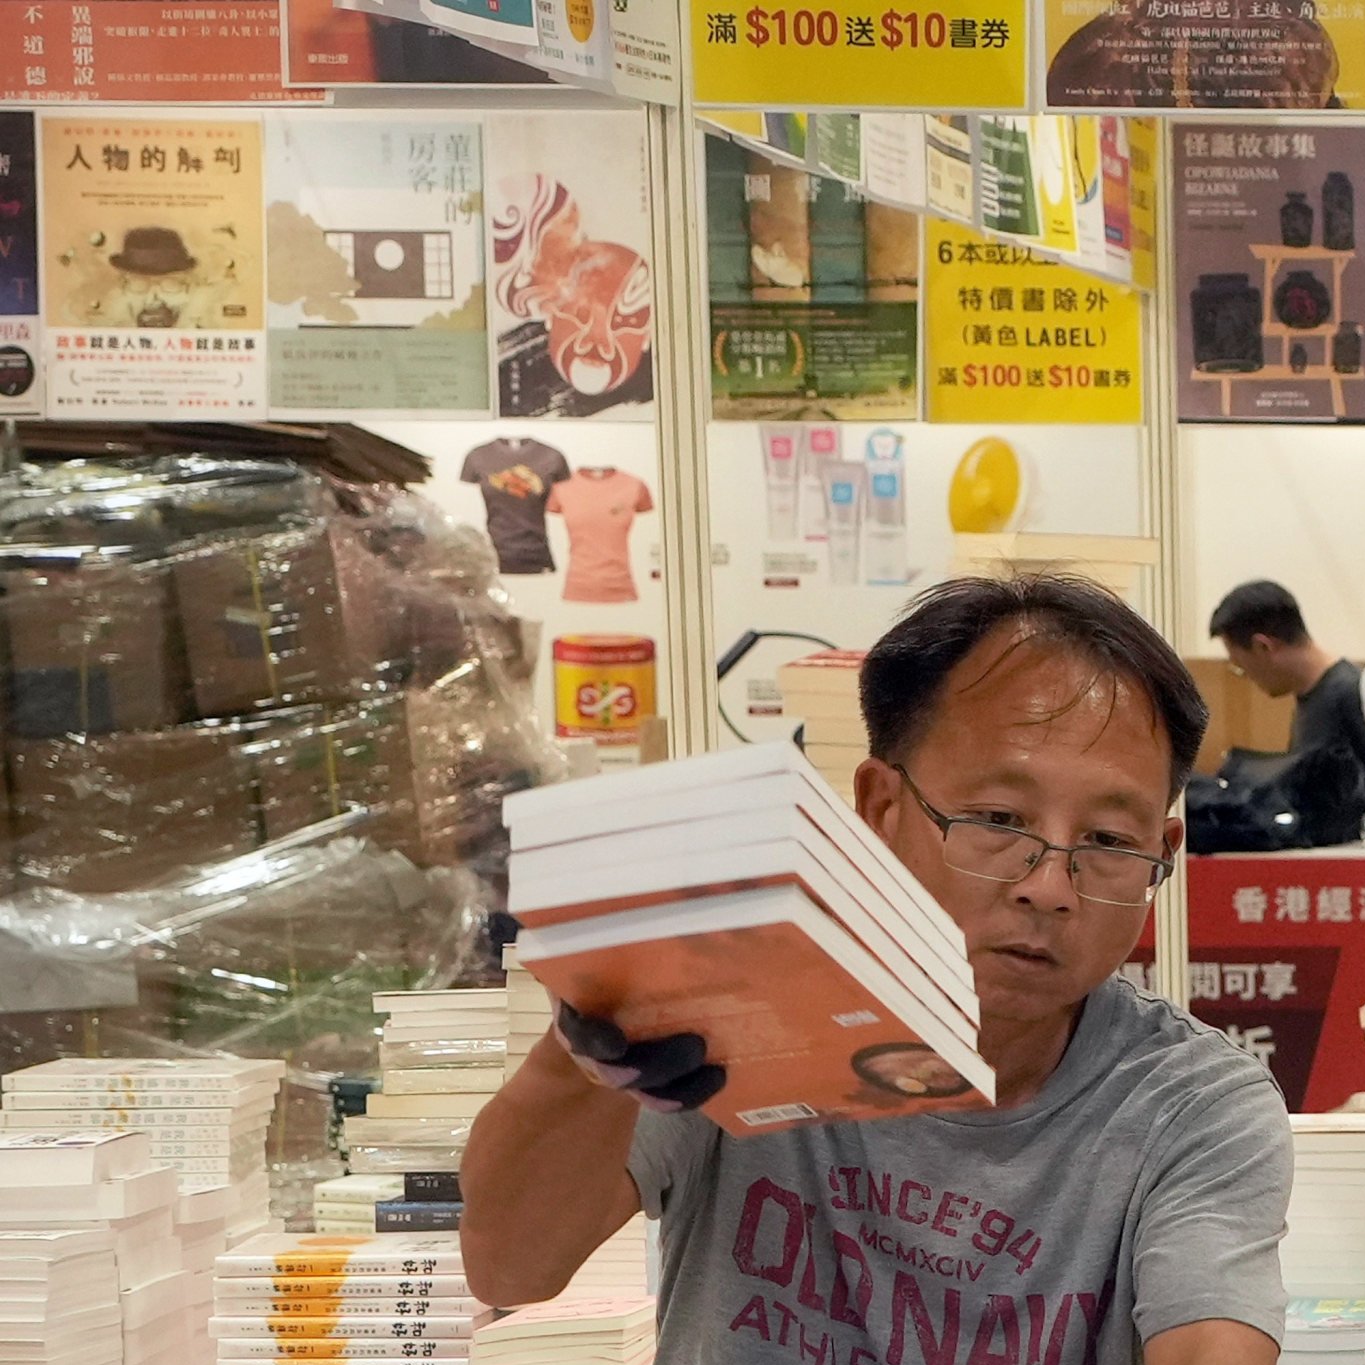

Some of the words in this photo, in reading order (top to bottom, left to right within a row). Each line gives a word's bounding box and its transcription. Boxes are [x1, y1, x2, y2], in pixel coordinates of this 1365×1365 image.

[707, 14, 737, 44] 滿
[745, 10, 839, 47] $100
[845, 18, 876, 46] 送
[949, 18, 1010, 48] 書券
[1183, 132, 1317, 160] 怪誕故事集
[957, 287, 1110, 314] 特價書除外
[1025, 326, 1107, 348] LABEL)
[938, 366, 957, 387] 滿
[963, 364, 1021, 389] $100
[1026, 368, 1046, 387] 送
[828, 1165, 1042, 1275] INCE'94
[732, 1176, 872, 1331] OLD
